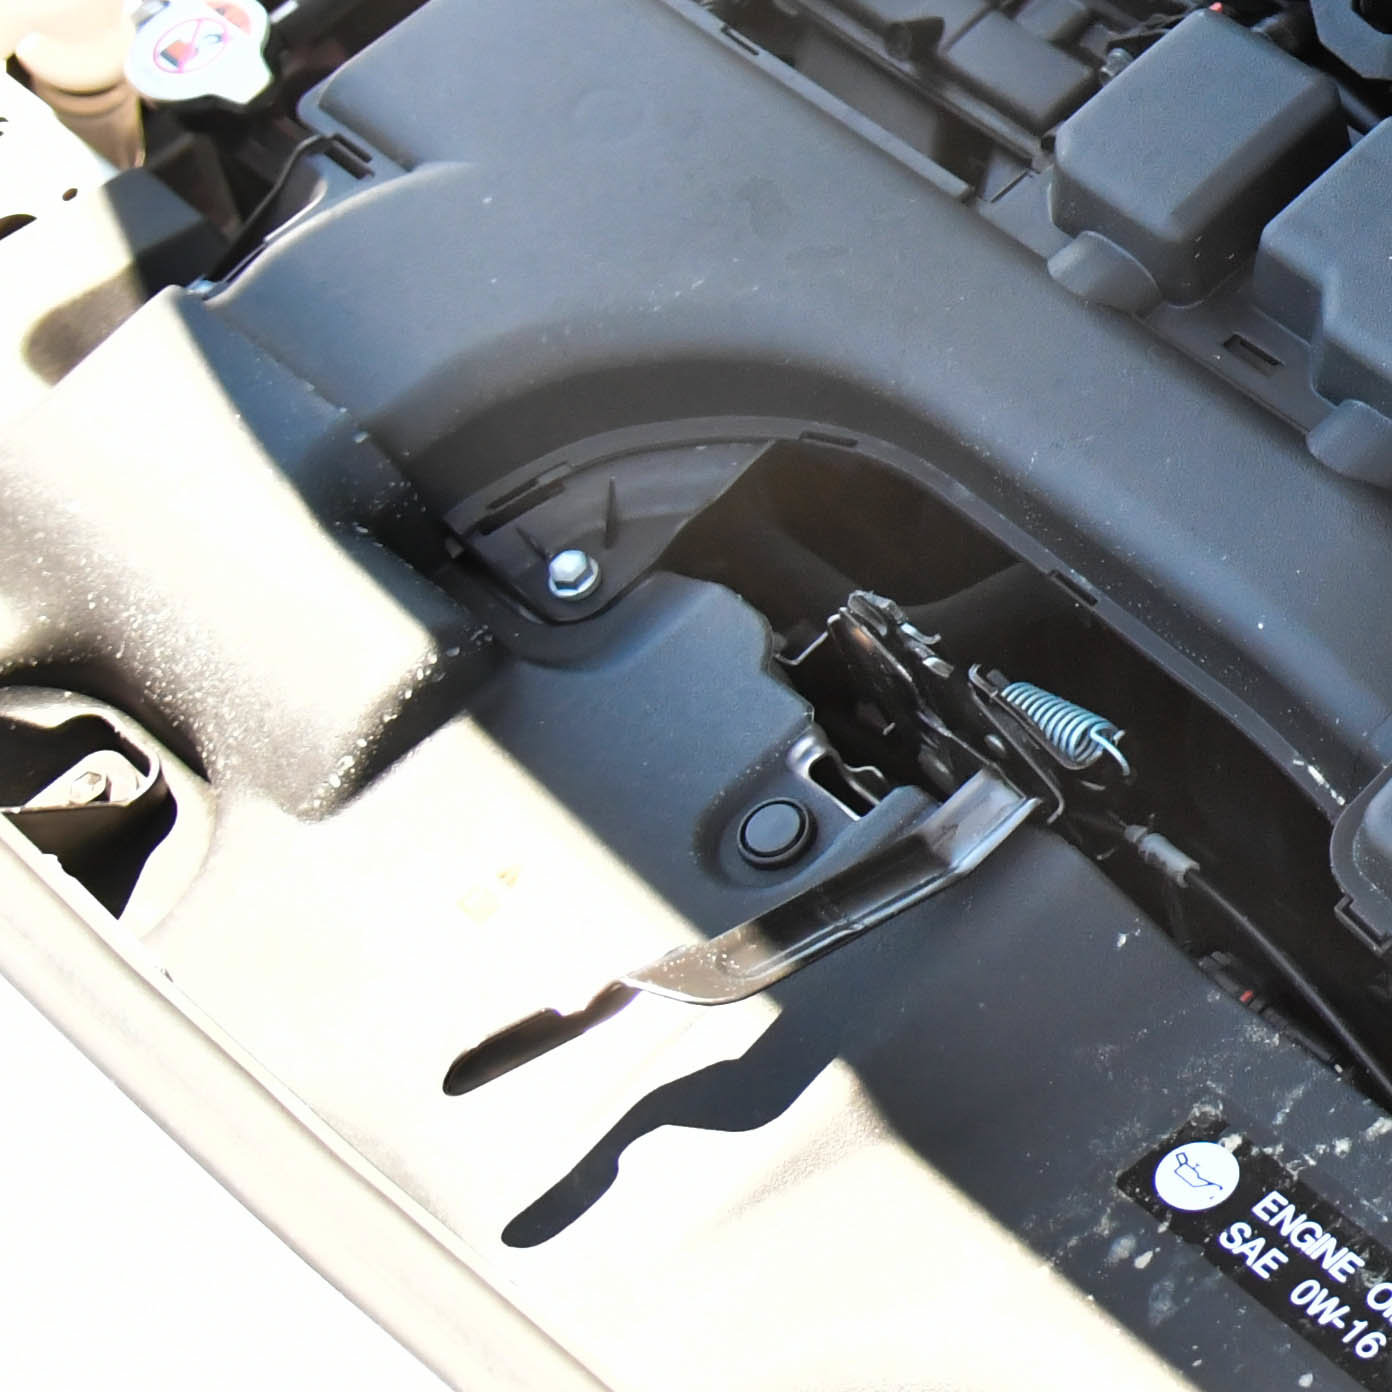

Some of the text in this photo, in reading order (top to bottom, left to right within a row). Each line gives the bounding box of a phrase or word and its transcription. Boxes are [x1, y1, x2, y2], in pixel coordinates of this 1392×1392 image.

[1218, 1221, 1387, 1360] SAE 0W-16
[1251, 1190, 1365, 1283] ENGINE
